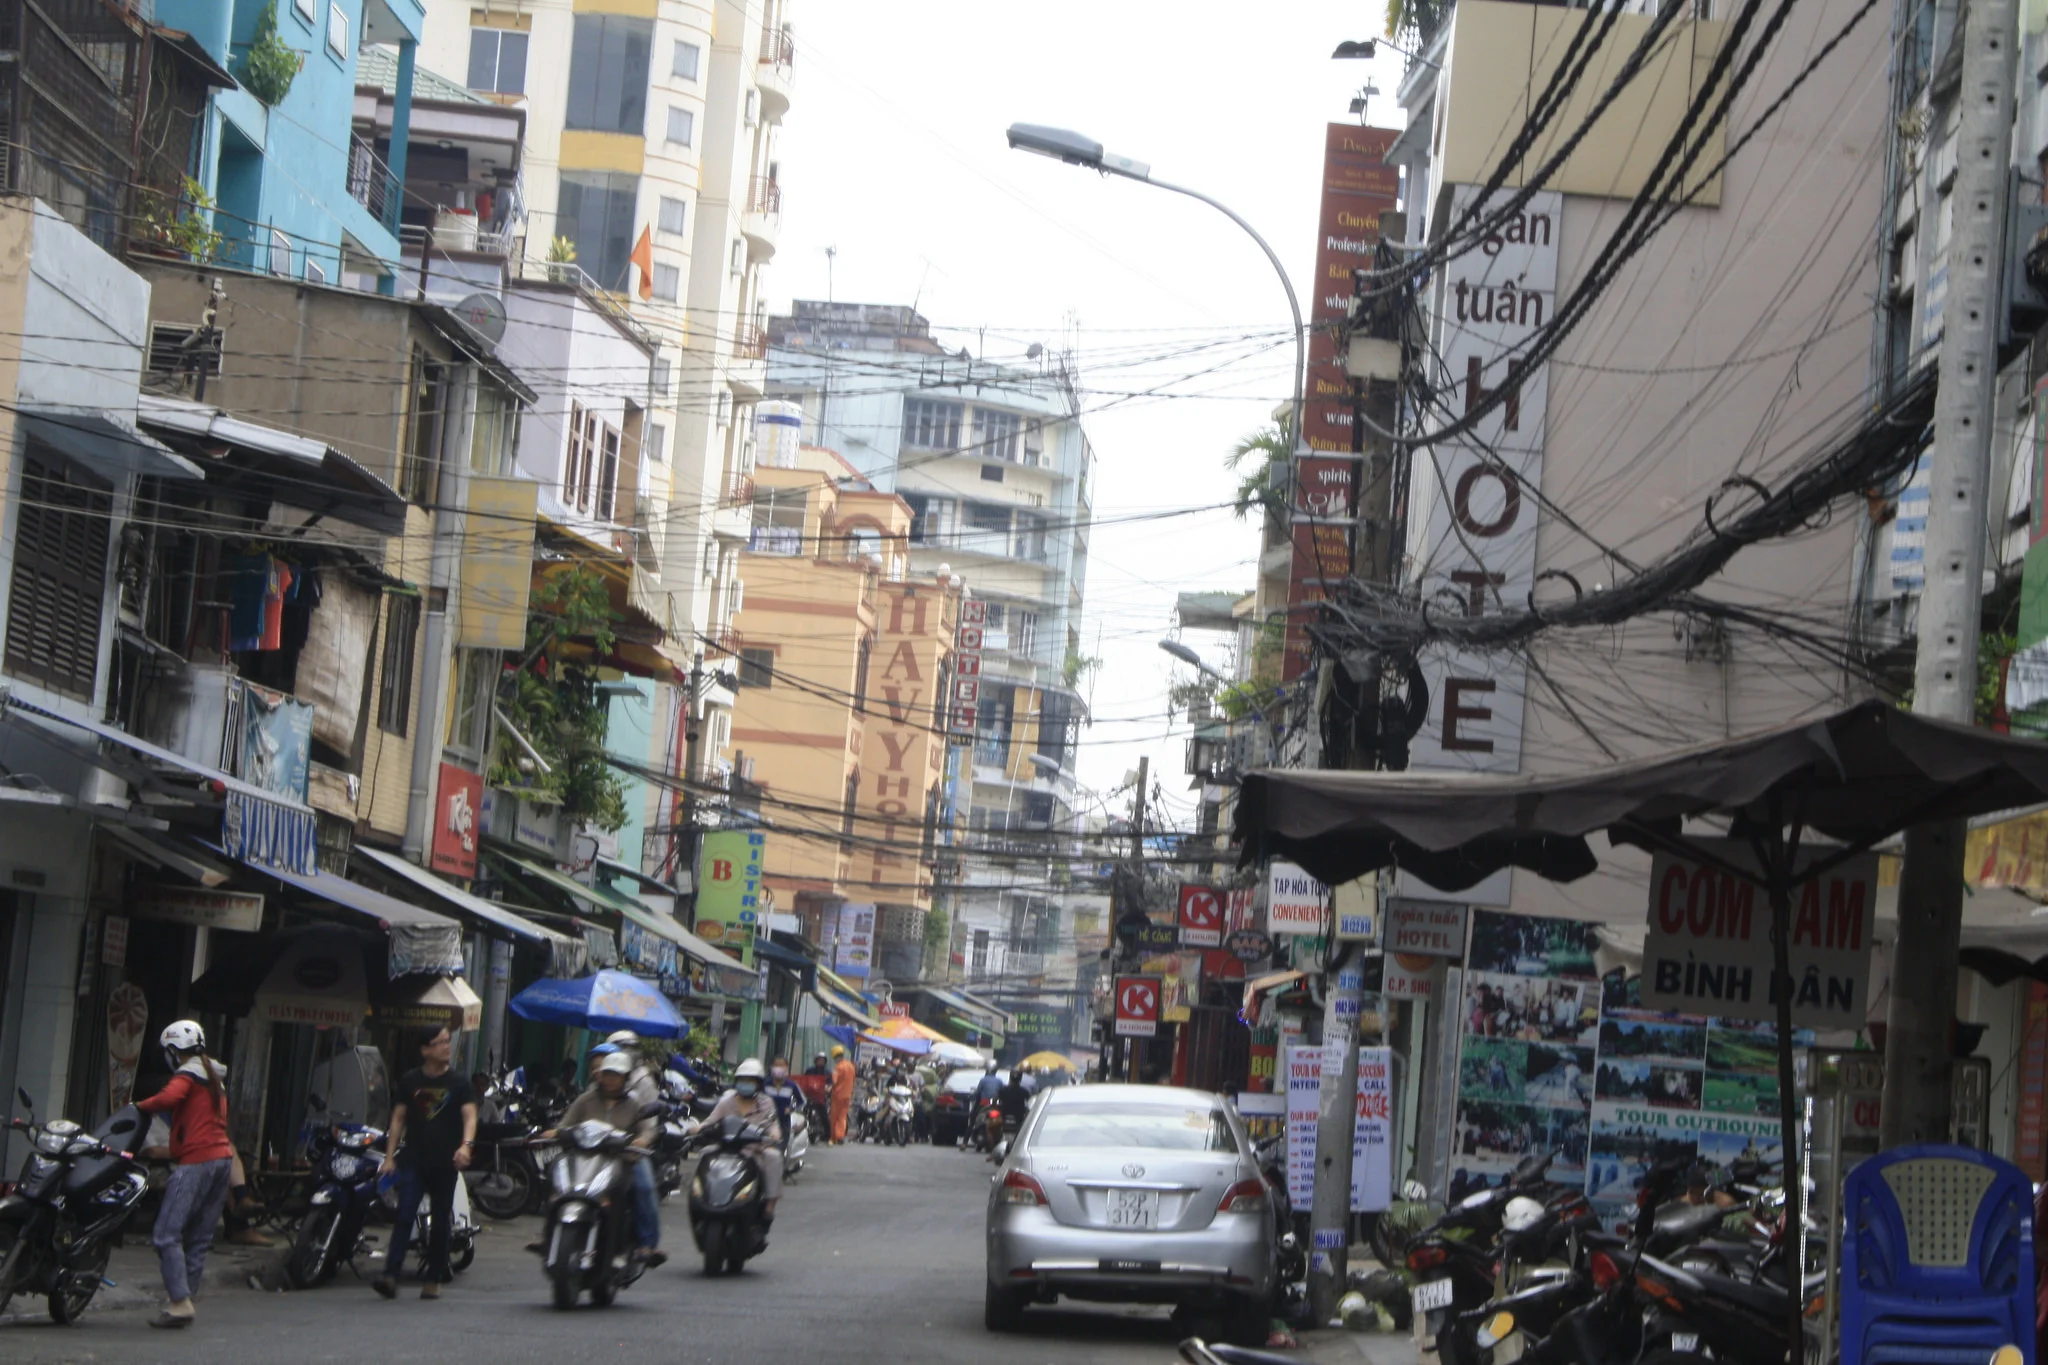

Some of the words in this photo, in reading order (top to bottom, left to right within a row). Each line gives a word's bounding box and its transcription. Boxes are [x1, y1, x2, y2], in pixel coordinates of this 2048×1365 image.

[1455, 273, 1543, 327] tuấn
[954, 602, 982, 727] HOTEL
[739, 833, 764, 922] BISTRO
[1397, 929, 1451, 950] HOTEL
[1654, 949, 1753, 1002] BÌNH
[1615, 1108, 1669, 1128] TOUR
[1112, 1207, 1149, 1227] 3171
